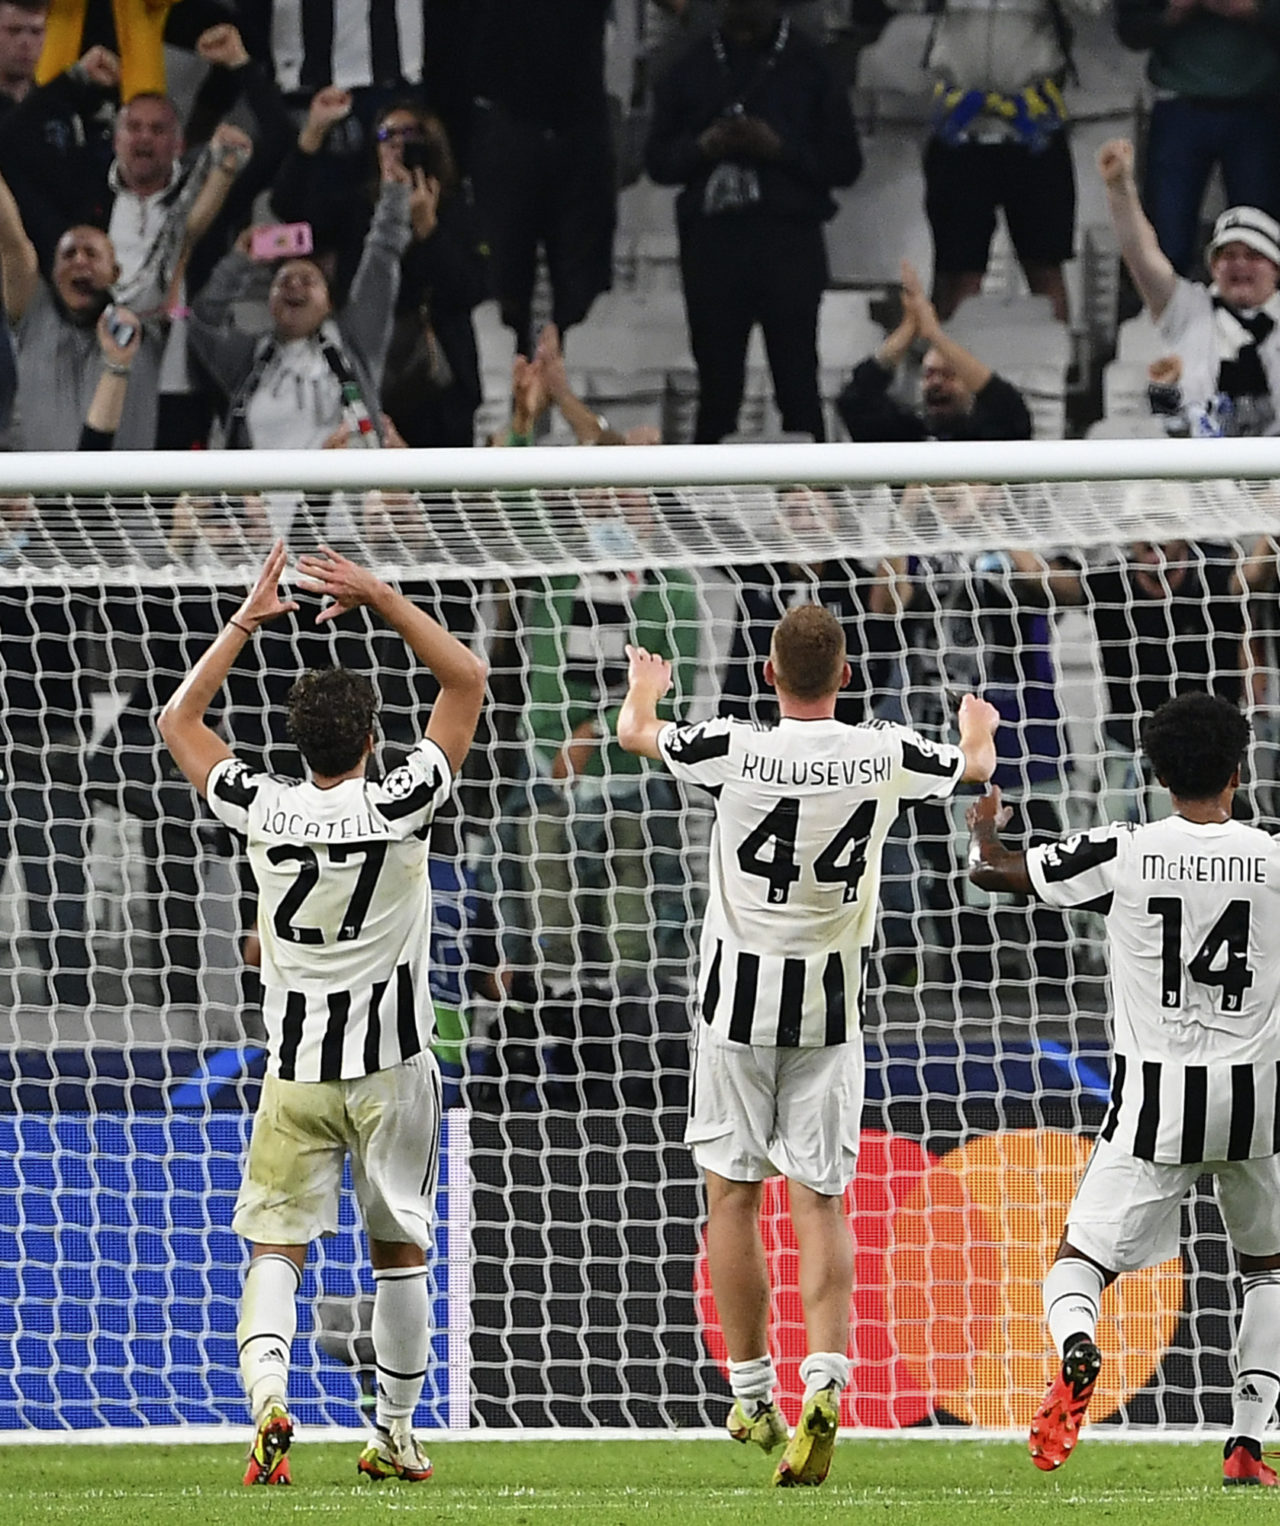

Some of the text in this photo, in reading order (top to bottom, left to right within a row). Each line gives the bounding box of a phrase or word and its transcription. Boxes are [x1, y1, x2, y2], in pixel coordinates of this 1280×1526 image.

[741, 753, 892, 786] KULUSEVSKI
[266, 840, 389, 945] 27
[737, 796, 879, 904] 44
[1148, 897, 1254, 1012] 14
